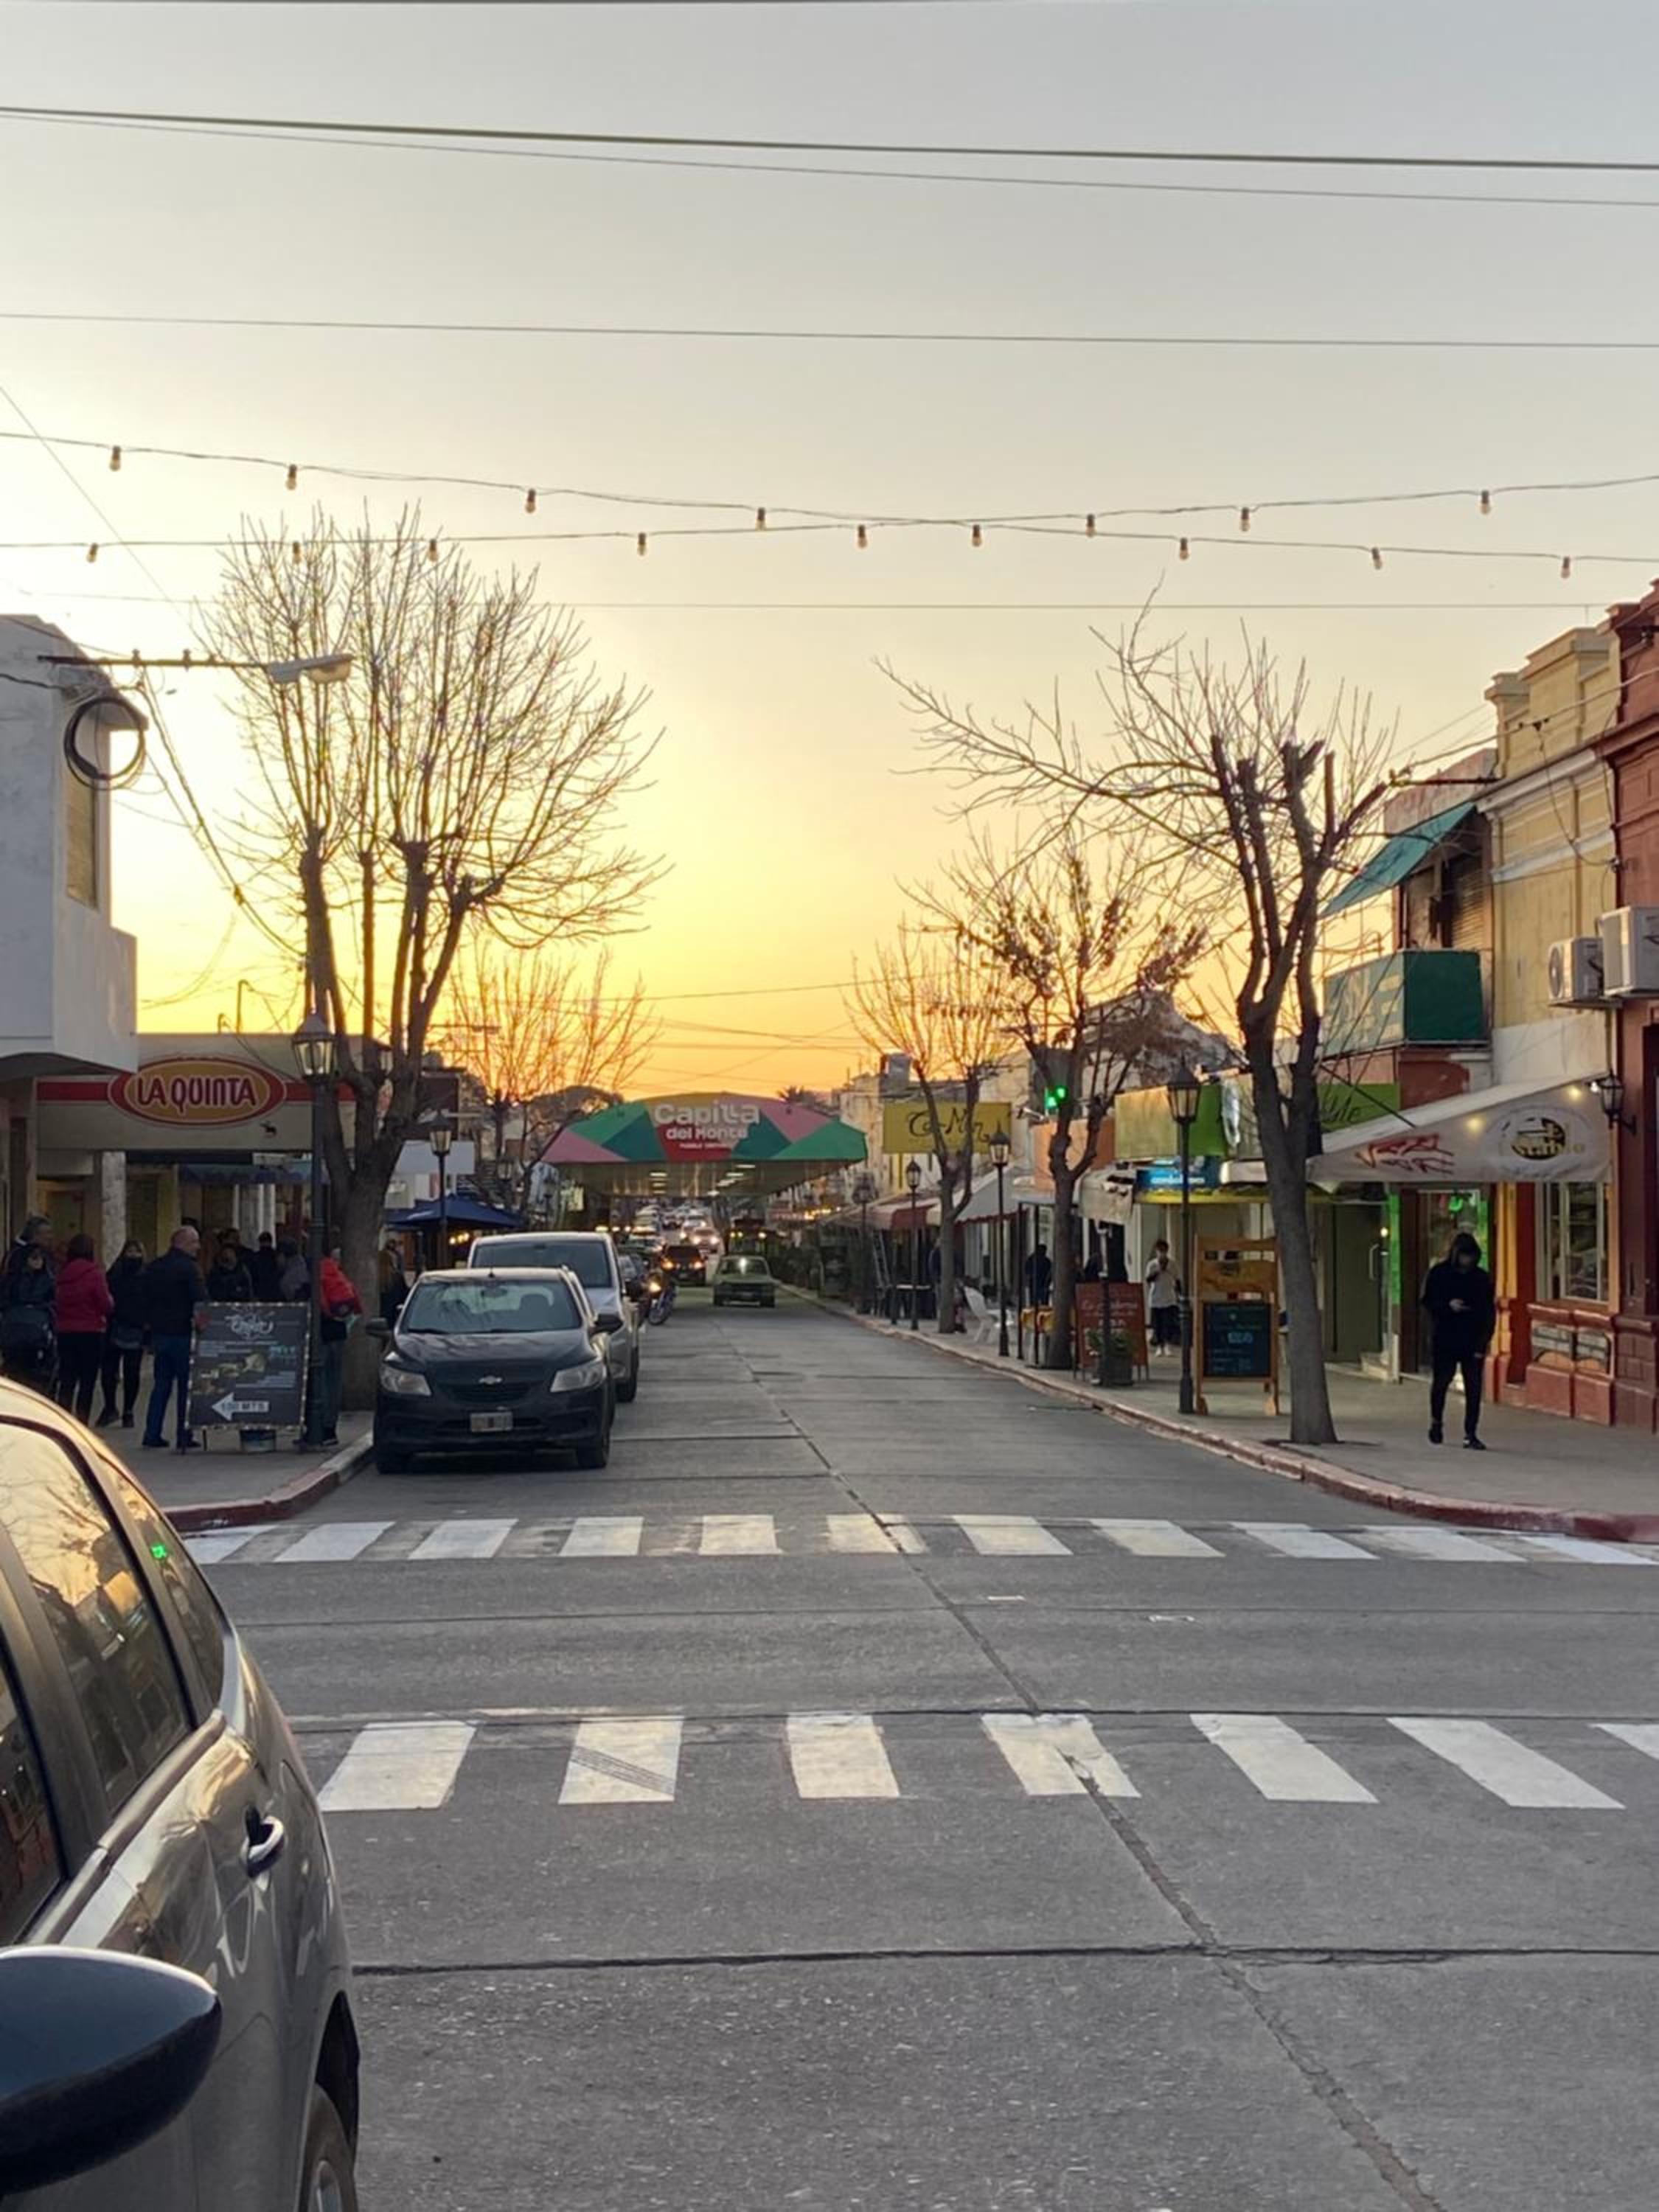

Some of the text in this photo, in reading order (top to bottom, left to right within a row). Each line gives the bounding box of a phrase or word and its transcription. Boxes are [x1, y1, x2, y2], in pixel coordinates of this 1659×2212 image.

[136, 1077, 257, 1113] LA QUINTA
[654, 1100, 760, 1126] Capilla
[666, 1127, 748, 1140] del Monte
